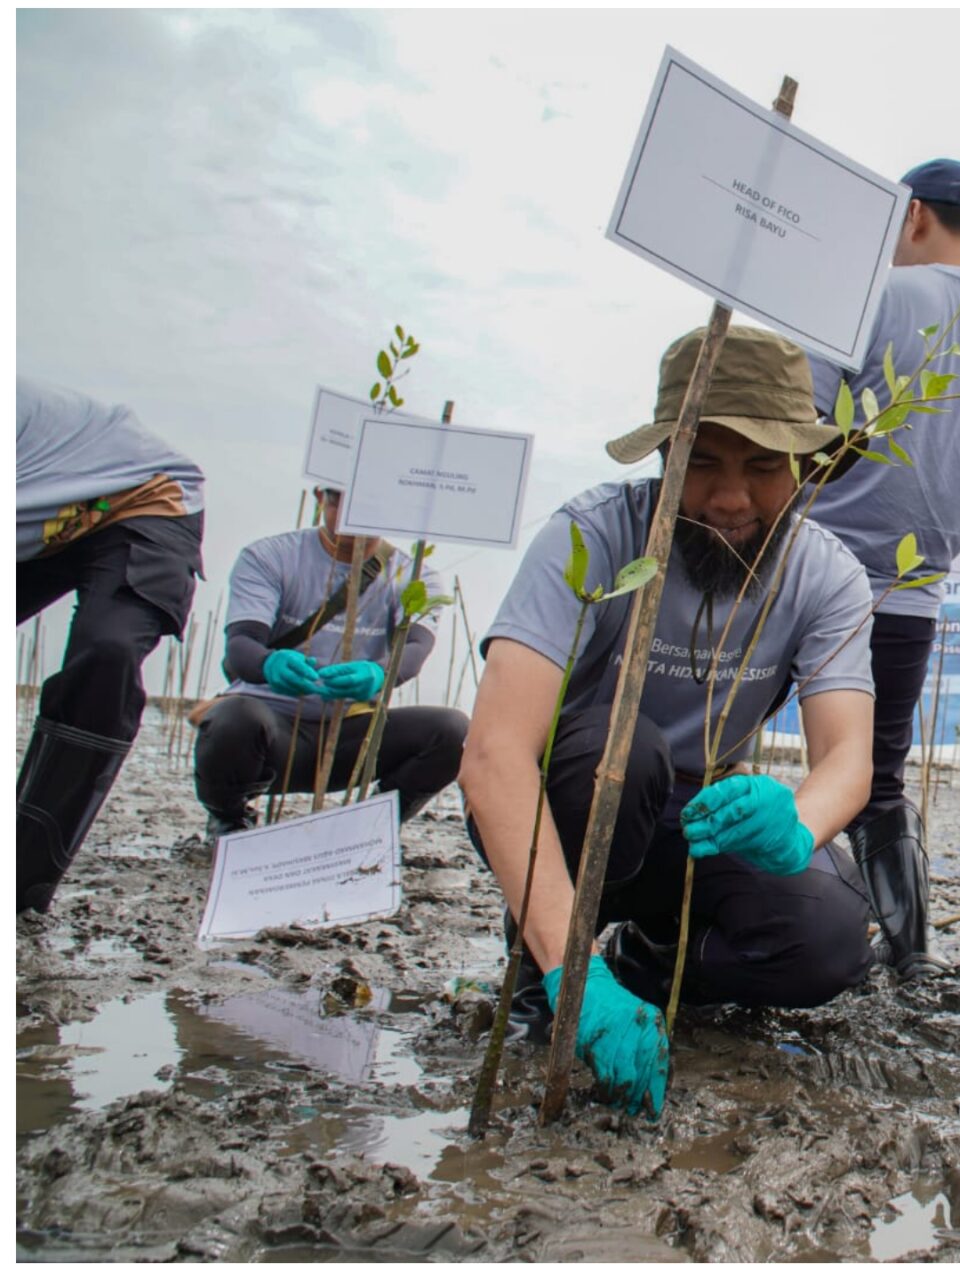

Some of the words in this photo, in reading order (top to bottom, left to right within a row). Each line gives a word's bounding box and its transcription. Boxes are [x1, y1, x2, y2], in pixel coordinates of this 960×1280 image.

[732, 179, 760, 201] HEAD
[762, 197, 776, 209] OF
[777, 205, 800, 224] FICO
[735, 203, 757, 223] RISA
[759, 217, 787, 238] BAYU
